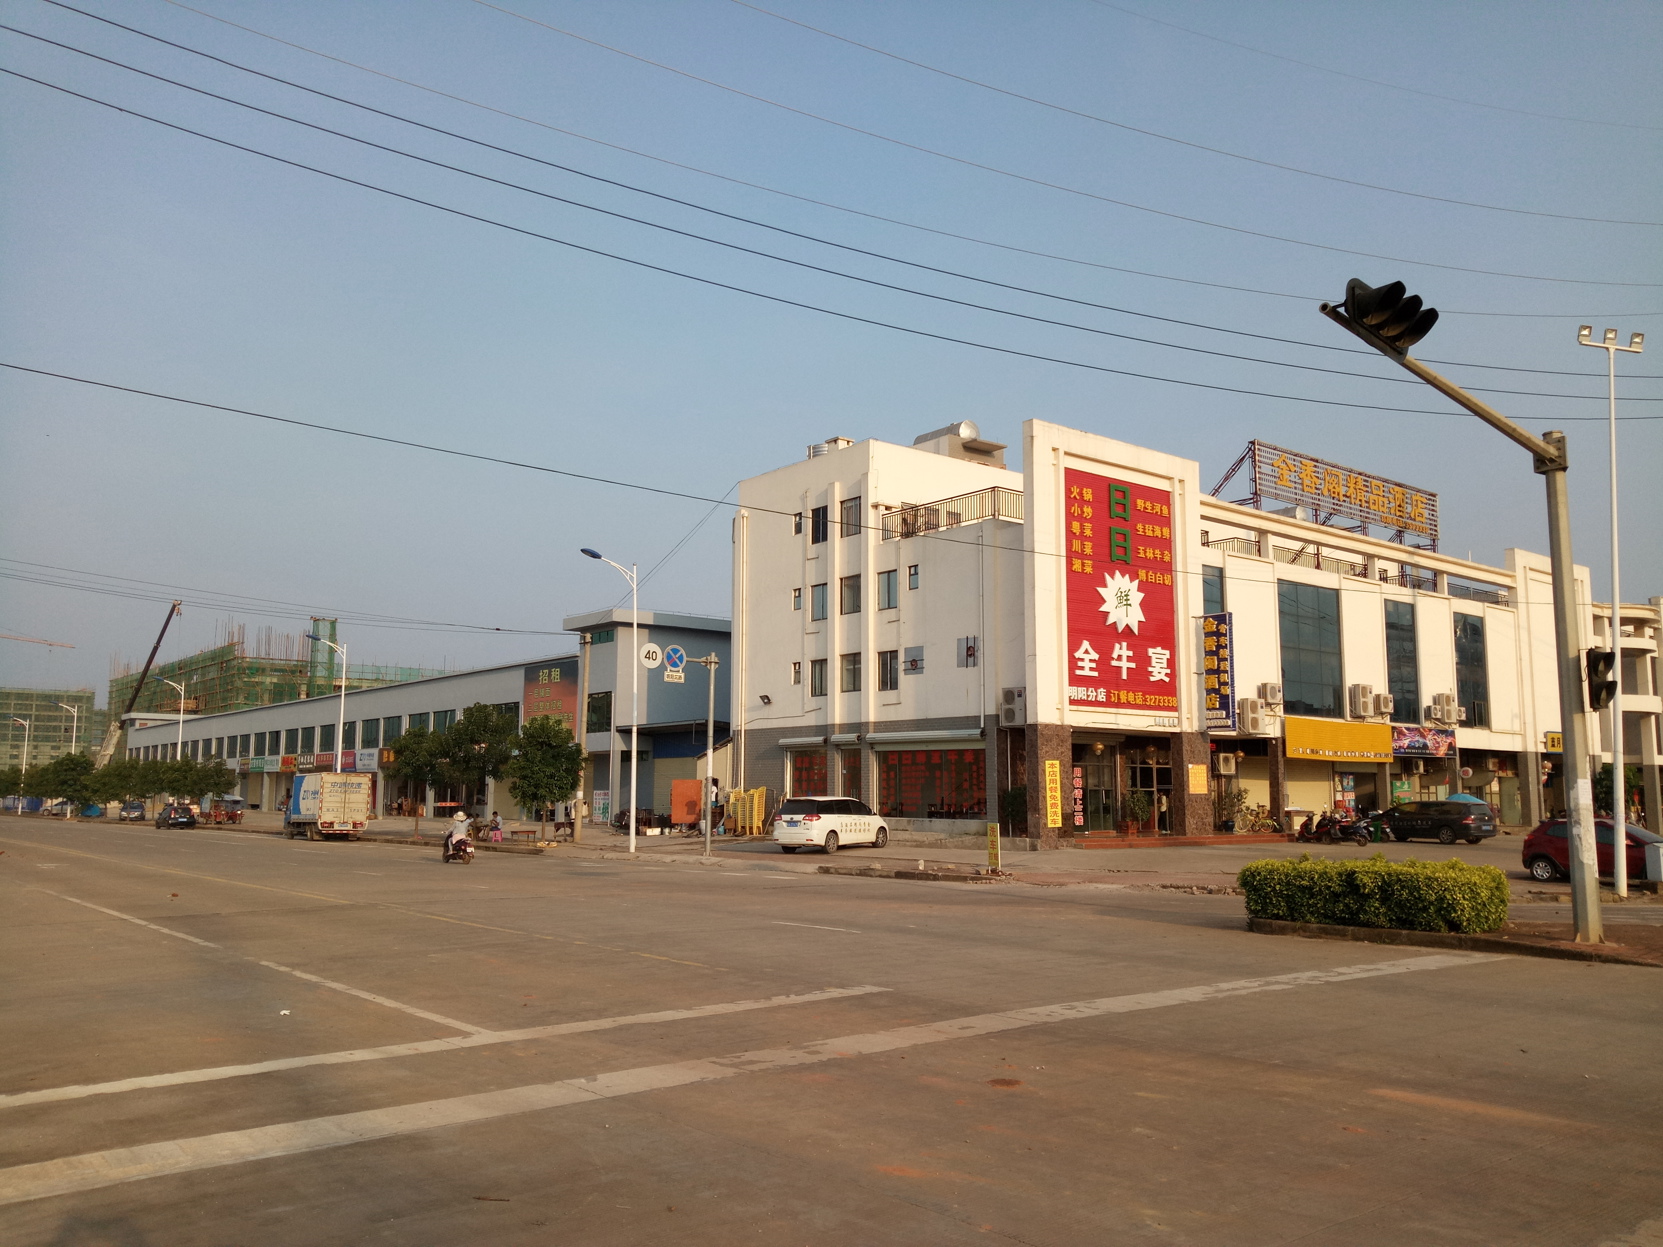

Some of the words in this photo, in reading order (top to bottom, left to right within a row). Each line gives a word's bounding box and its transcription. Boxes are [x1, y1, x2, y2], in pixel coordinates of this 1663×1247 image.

[1070, 485, 1093, 502] 火锅
[1272, 454, 1428, 523] 金香阁精品酒店
[1070, 503, 1093, 519] 小炒
[1136, 498, 1170, 518] 野生河鱼
[1070, 521, 1093, 538] 粤菜
[1136, 523, 1171, 540] 生猛海鲜
[1071, 539, 1094, 556] 川菜
[1137, 547, 1171, 562] 玉林牛杂
[1071, 558, 1094, 575] 湘菜
[1138, 570, 1172, 586] 博白白切
[644, 650, 658, 662] 40
[1073, 640, 1172, 683] 全牛宴
[1203, 617, 1220, 709] 金香阁酒店
[539, 668, 560, 684] 招租
[1068, 685, 1107, 703] 明阳分店
[1047, 762, 1060, 826] 本店用餐免费洗车
[988, 826, 997, 851] 洗车
